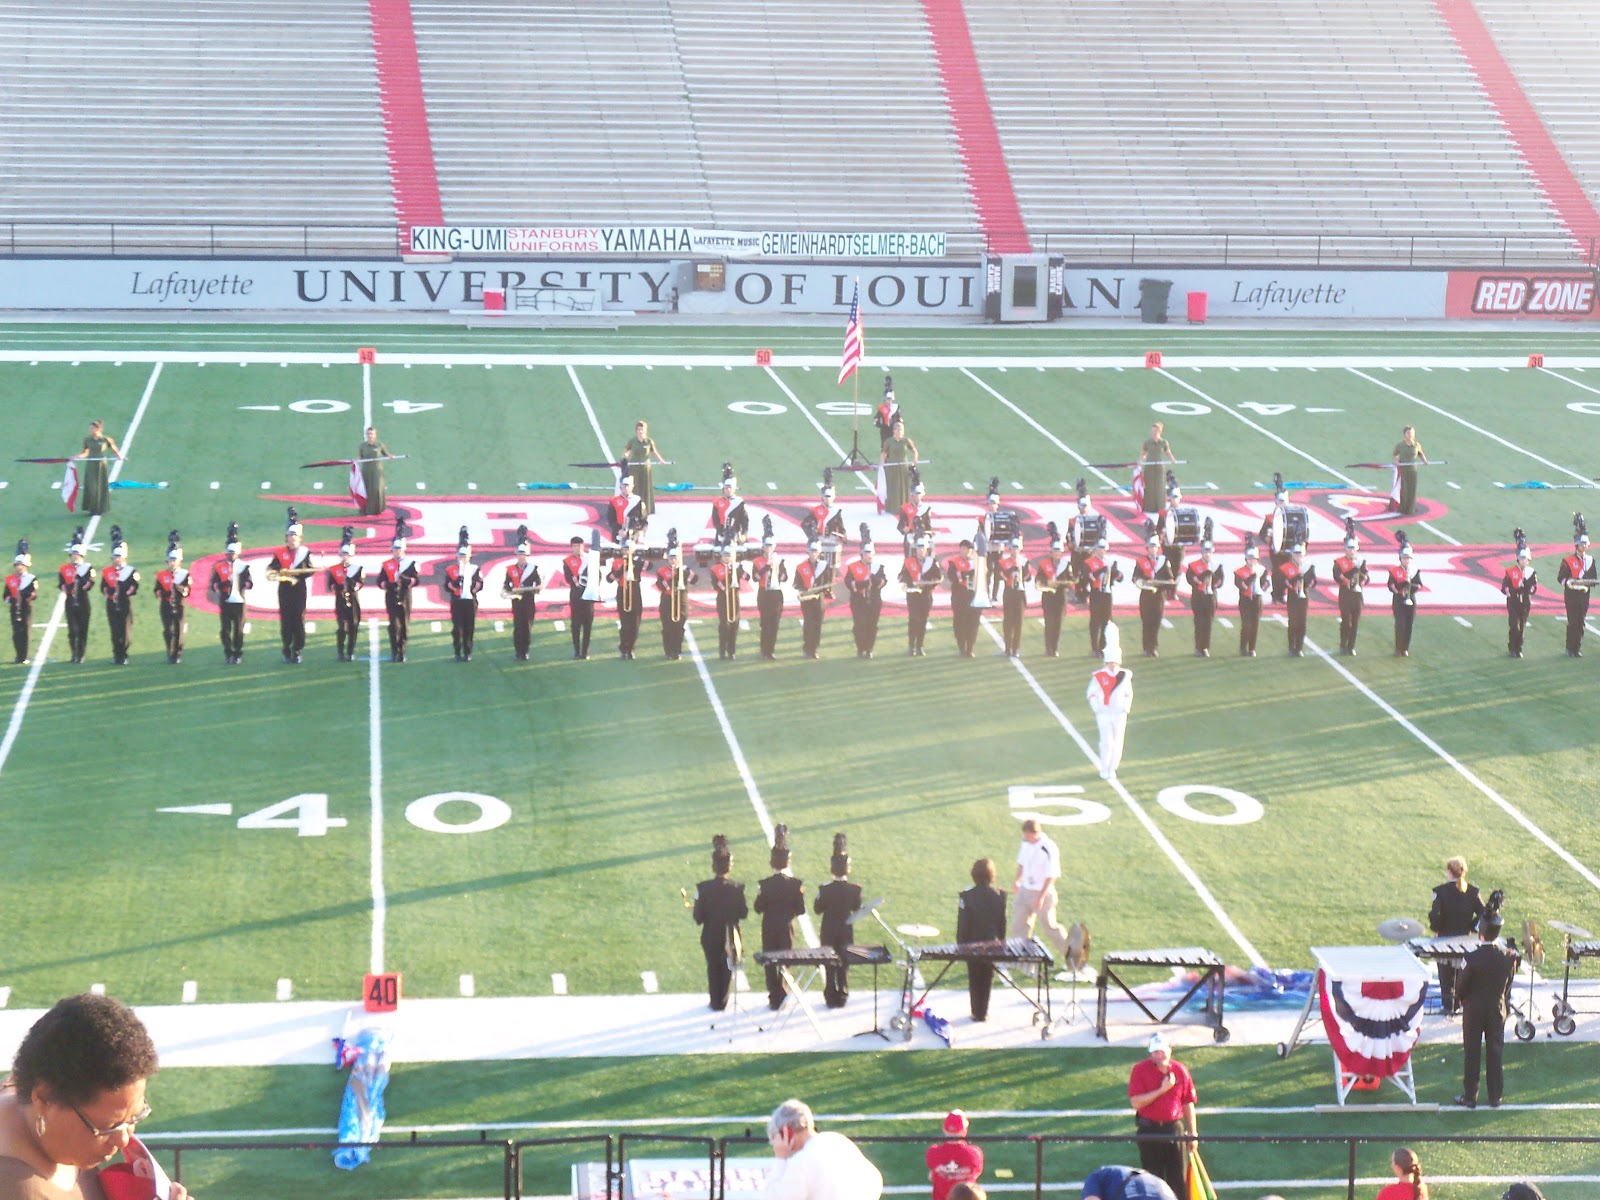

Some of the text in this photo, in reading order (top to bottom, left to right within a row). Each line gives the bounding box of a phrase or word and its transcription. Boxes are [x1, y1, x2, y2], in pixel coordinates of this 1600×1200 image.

[412, 228, 507, 251] KING-UMI
[507, 229, 599, 239] STANBURY
[601, 229, 692, 251] YAMAHA
[693, 236, 760, 247] LAFAYETTE MUSIC
[761, 233, 853, 256] GEMEINHARDT
[853, 234, 946, 256] SELMER-BACH
[509, 241, 599, 251] UNIFORMS
[130, 270, 254, 301] Lafayette
[734, 272, 807, 305] OF
[1232, 279, 1347, 311] Lafayette
[1476, 282, 1595, 311] RED ZONE
[756, 350, 770, 364] 50
[1148, 352, 1161, 365] 40
[1530, 355, 1544, 368] 30
[368, 977, 397, 1007] 40
